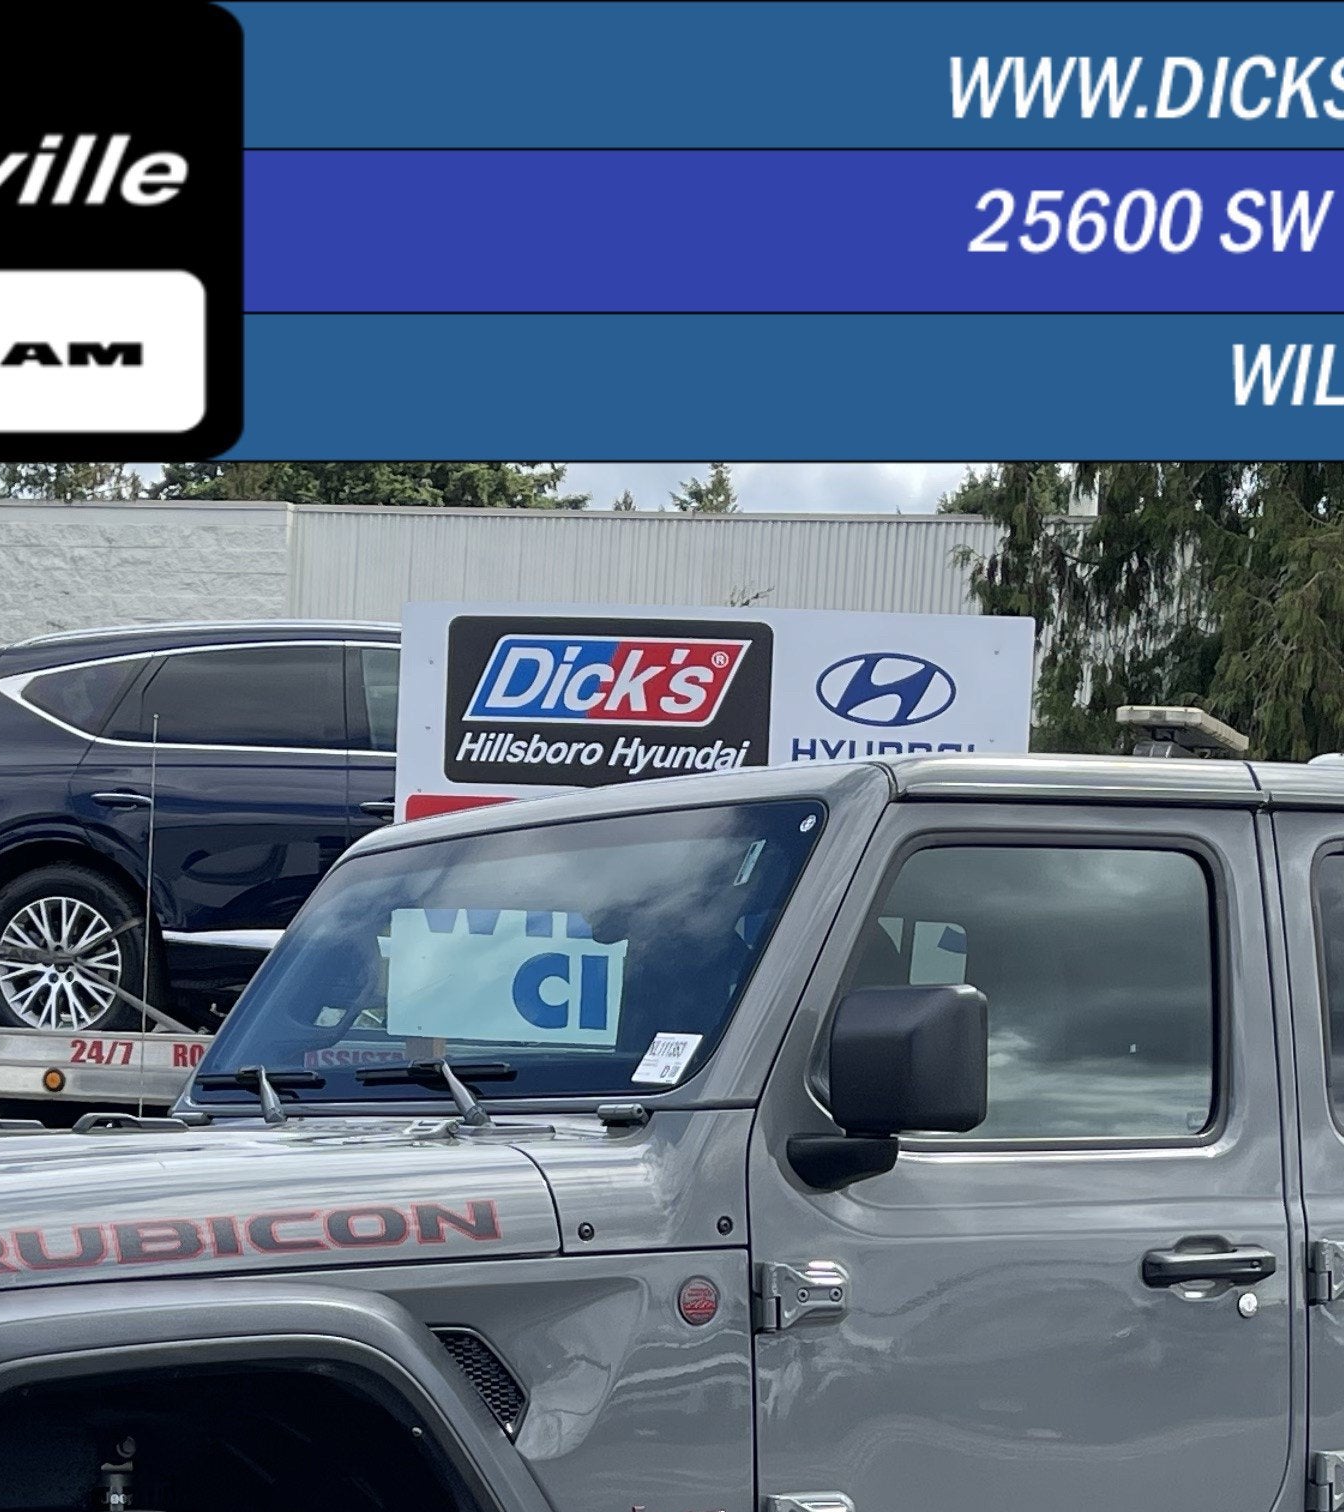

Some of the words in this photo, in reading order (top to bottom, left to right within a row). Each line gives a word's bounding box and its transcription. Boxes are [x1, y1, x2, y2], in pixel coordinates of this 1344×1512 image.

[484, 644, 714, 716] Dick's
[455, 732, 604, 766] Hillsboro
[608, 737, 751, 775] Hyundai
[70, 1038, 134, 1066] 24/7
